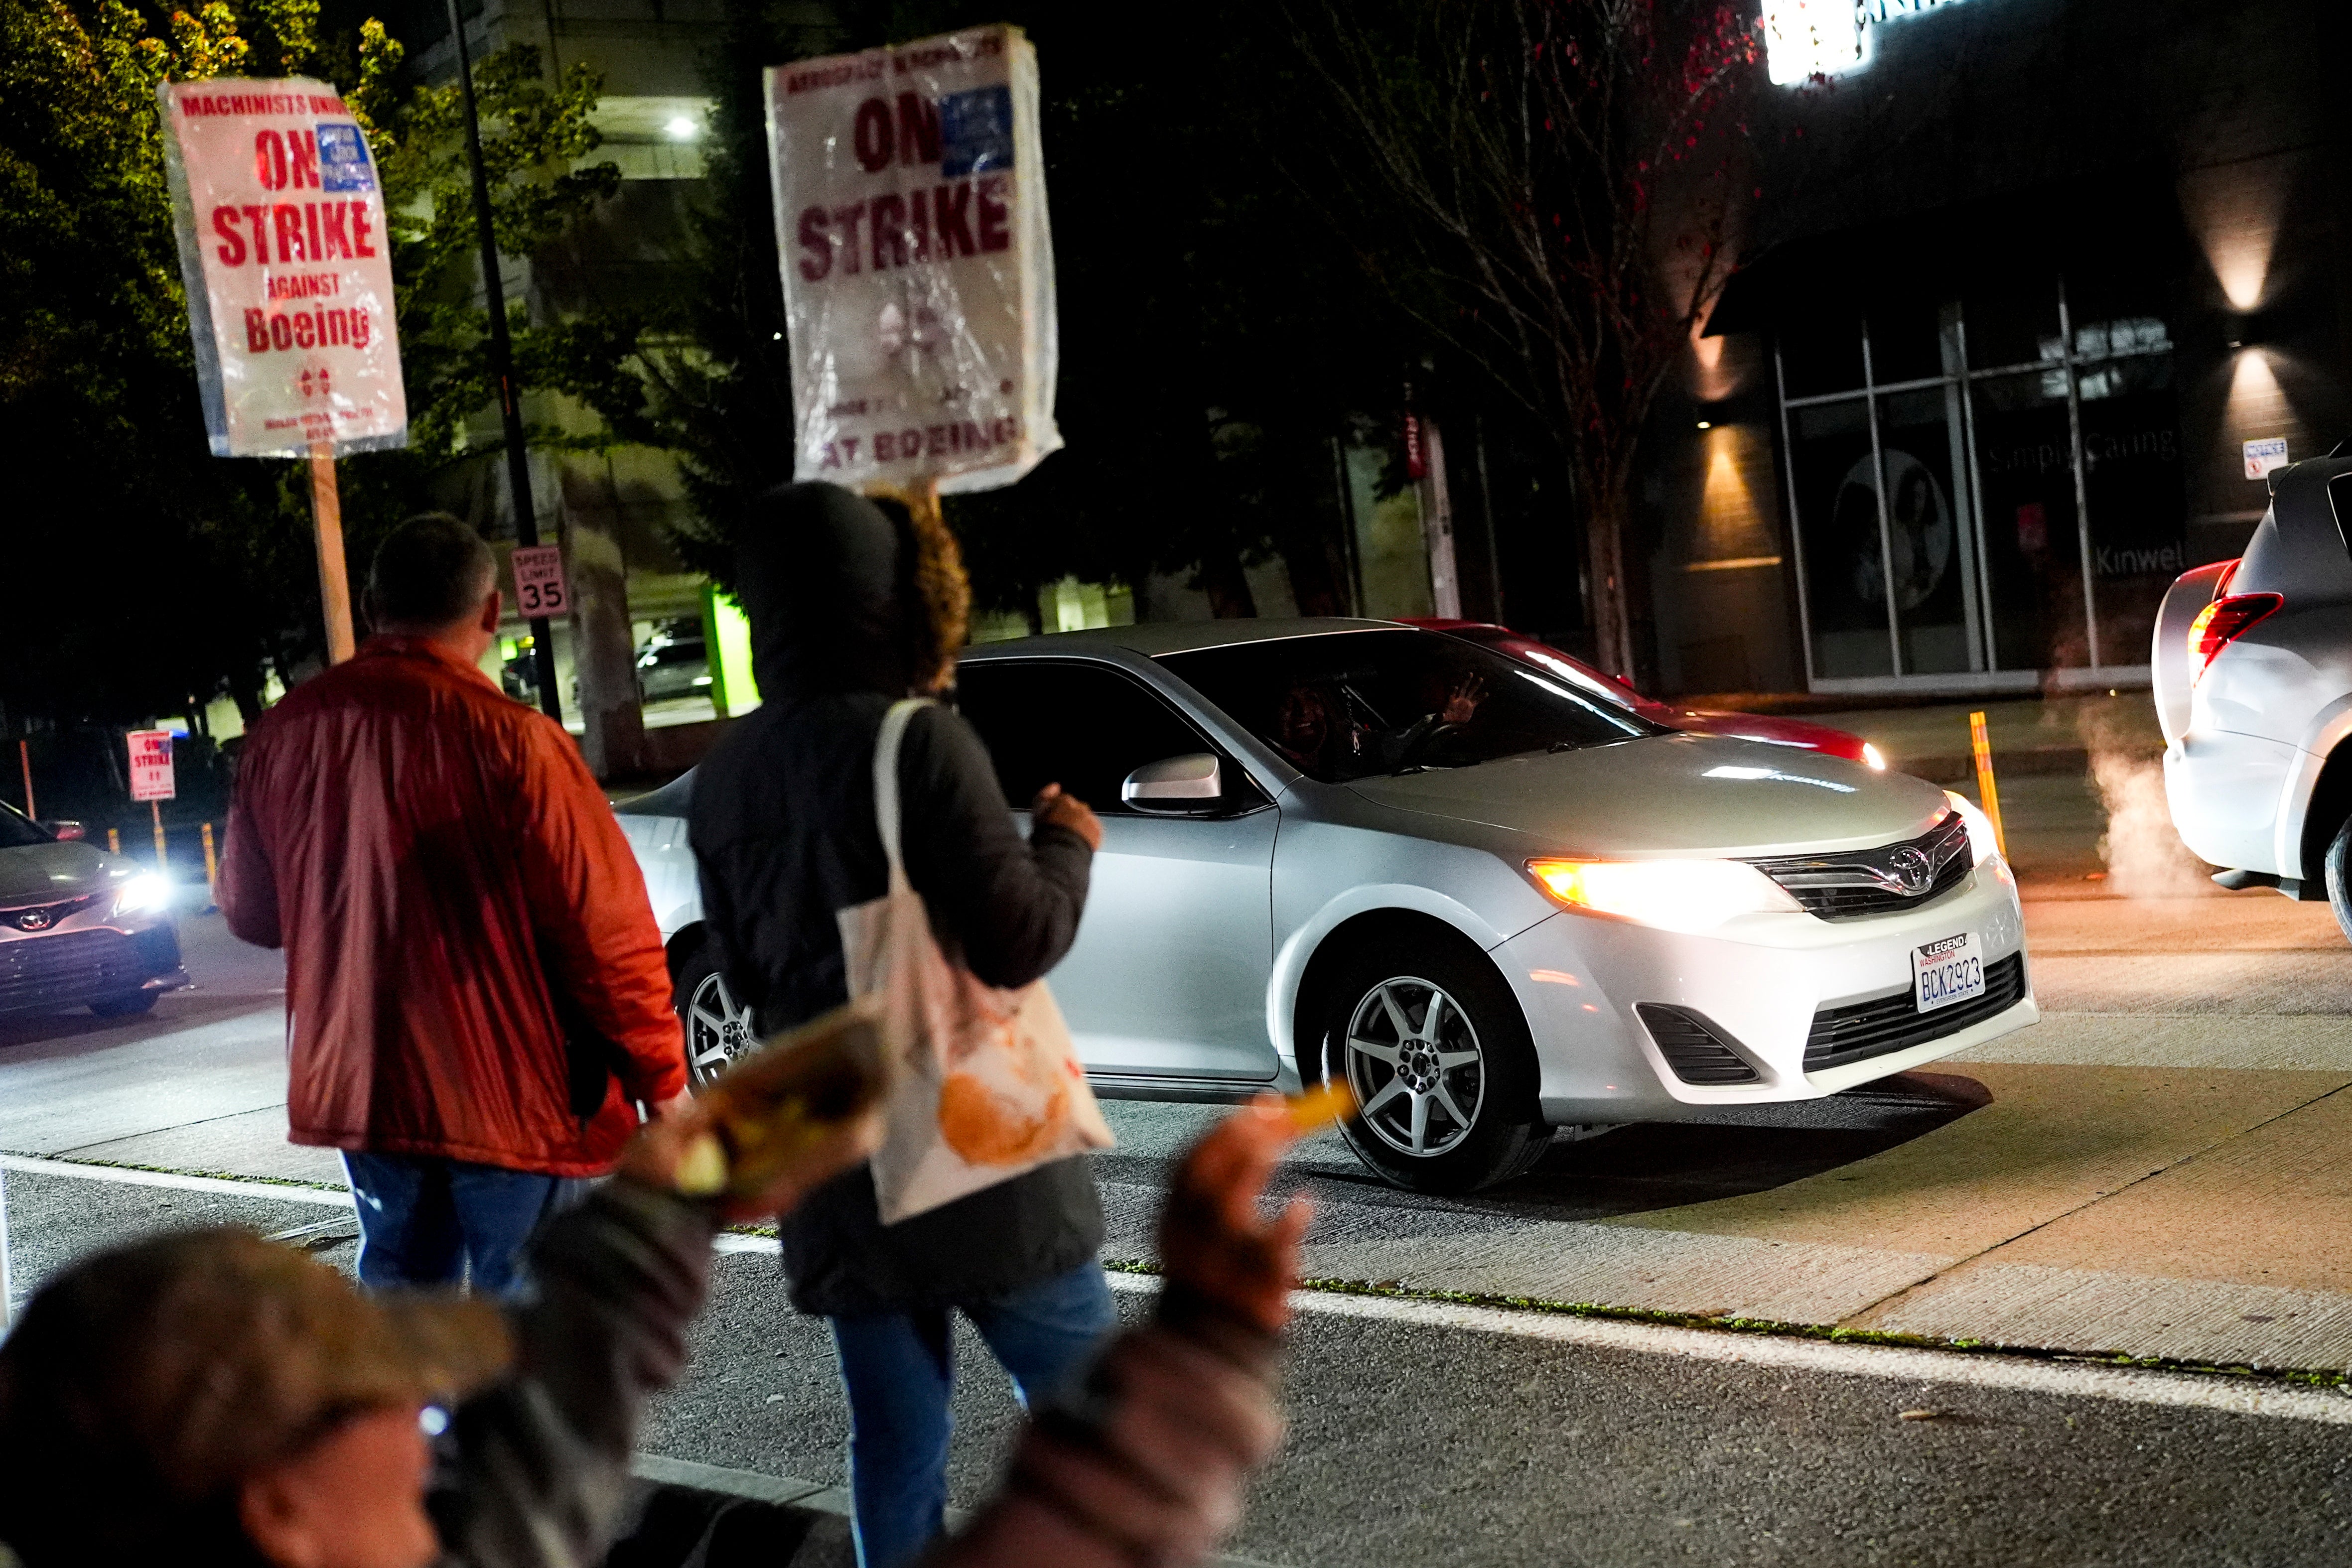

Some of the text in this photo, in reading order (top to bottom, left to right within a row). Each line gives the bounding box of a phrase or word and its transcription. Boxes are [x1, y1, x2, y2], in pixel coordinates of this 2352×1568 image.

[182, 94, 307, 117] MACHINISTS
[853, 91, 941, 173] ON
[254, 129, 320, 191] ON
[212, 202, 375, 267] STRIKE
[798, 176, 1011, 282] STRIKE
[267, 273, 339, 299] AGAINST
[244, 302, 370, 353] Boeing
[820, 415, 1017, 469] AT BOEING
[523, 581, 562, 610] 35
[1919, 950, 1955, 967] WASHINGTON
[1929, 936, 1964, 956] LEGEND
[1922, 957, 1981, 1002] BCK2923
[1936, 994, 1957, 1004] EVERGREEN
